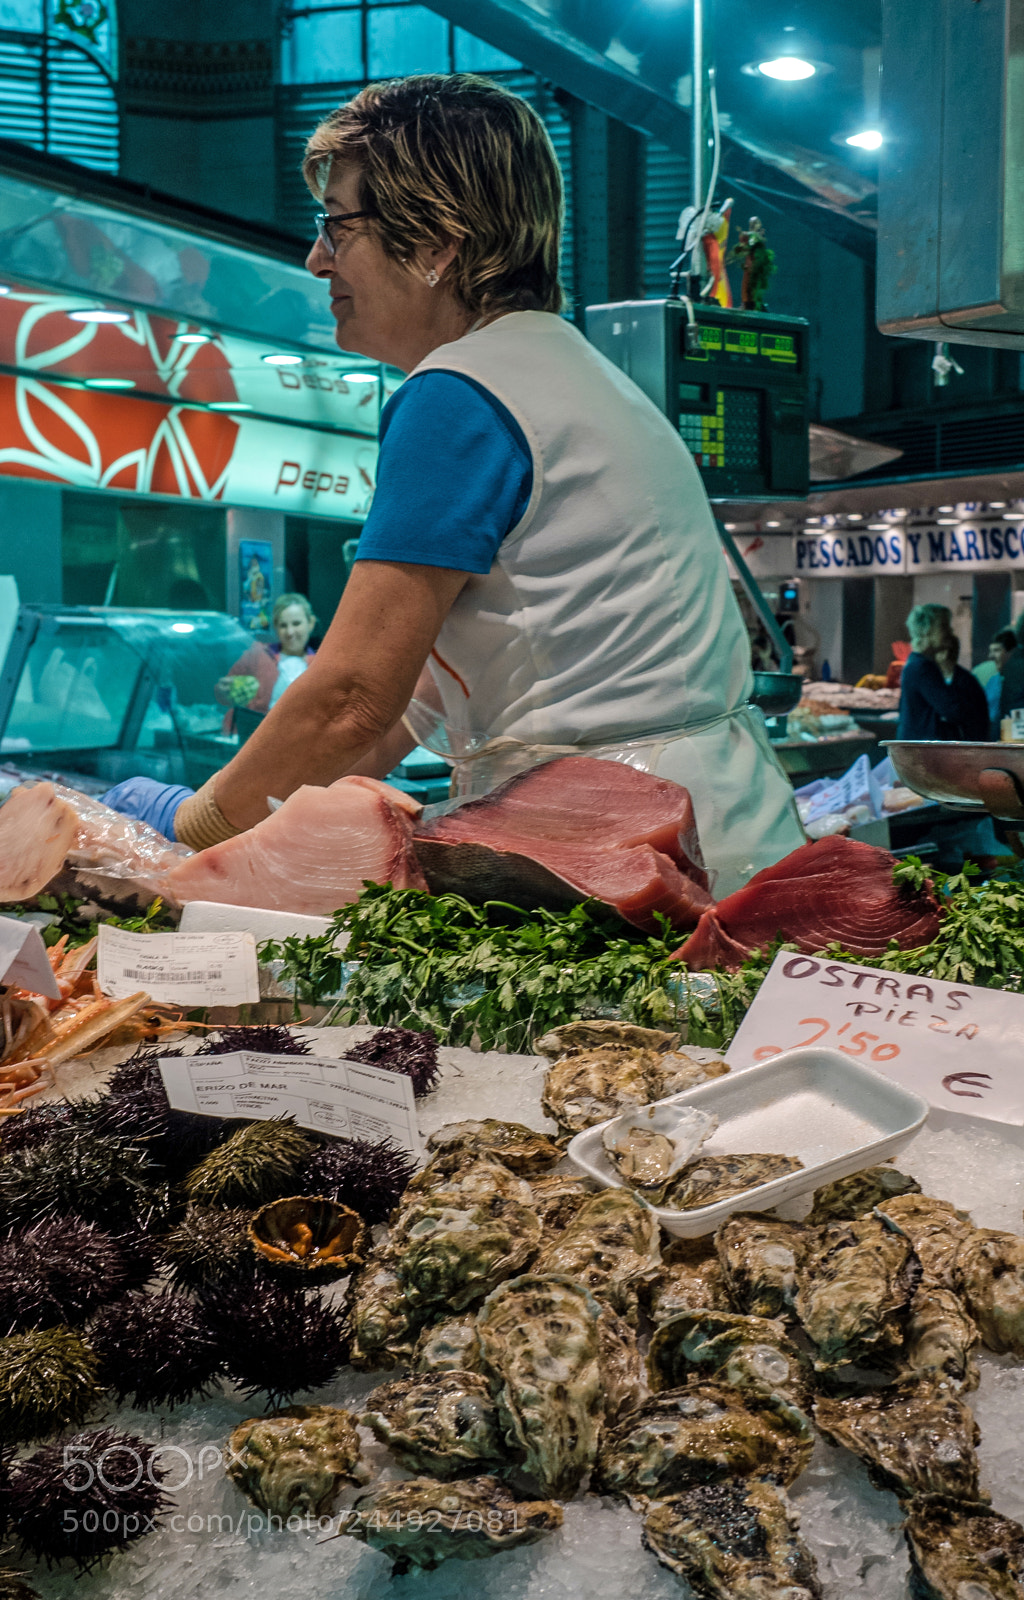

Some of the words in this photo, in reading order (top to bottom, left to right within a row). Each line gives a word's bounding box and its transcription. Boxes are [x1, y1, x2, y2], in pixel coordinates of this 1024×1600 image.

[274, 461, 350, 498] Pepa
[796, 534, 903, 569] PESCADOS
[907, 533, 922, 565] Y
[782, 957, 973, 1011] OSTRAS
[196, 1084, 236, 1092] ERIZO
[239, 1081, 256, 1090] DE
[260, 1083, 288, 1091] MAR
